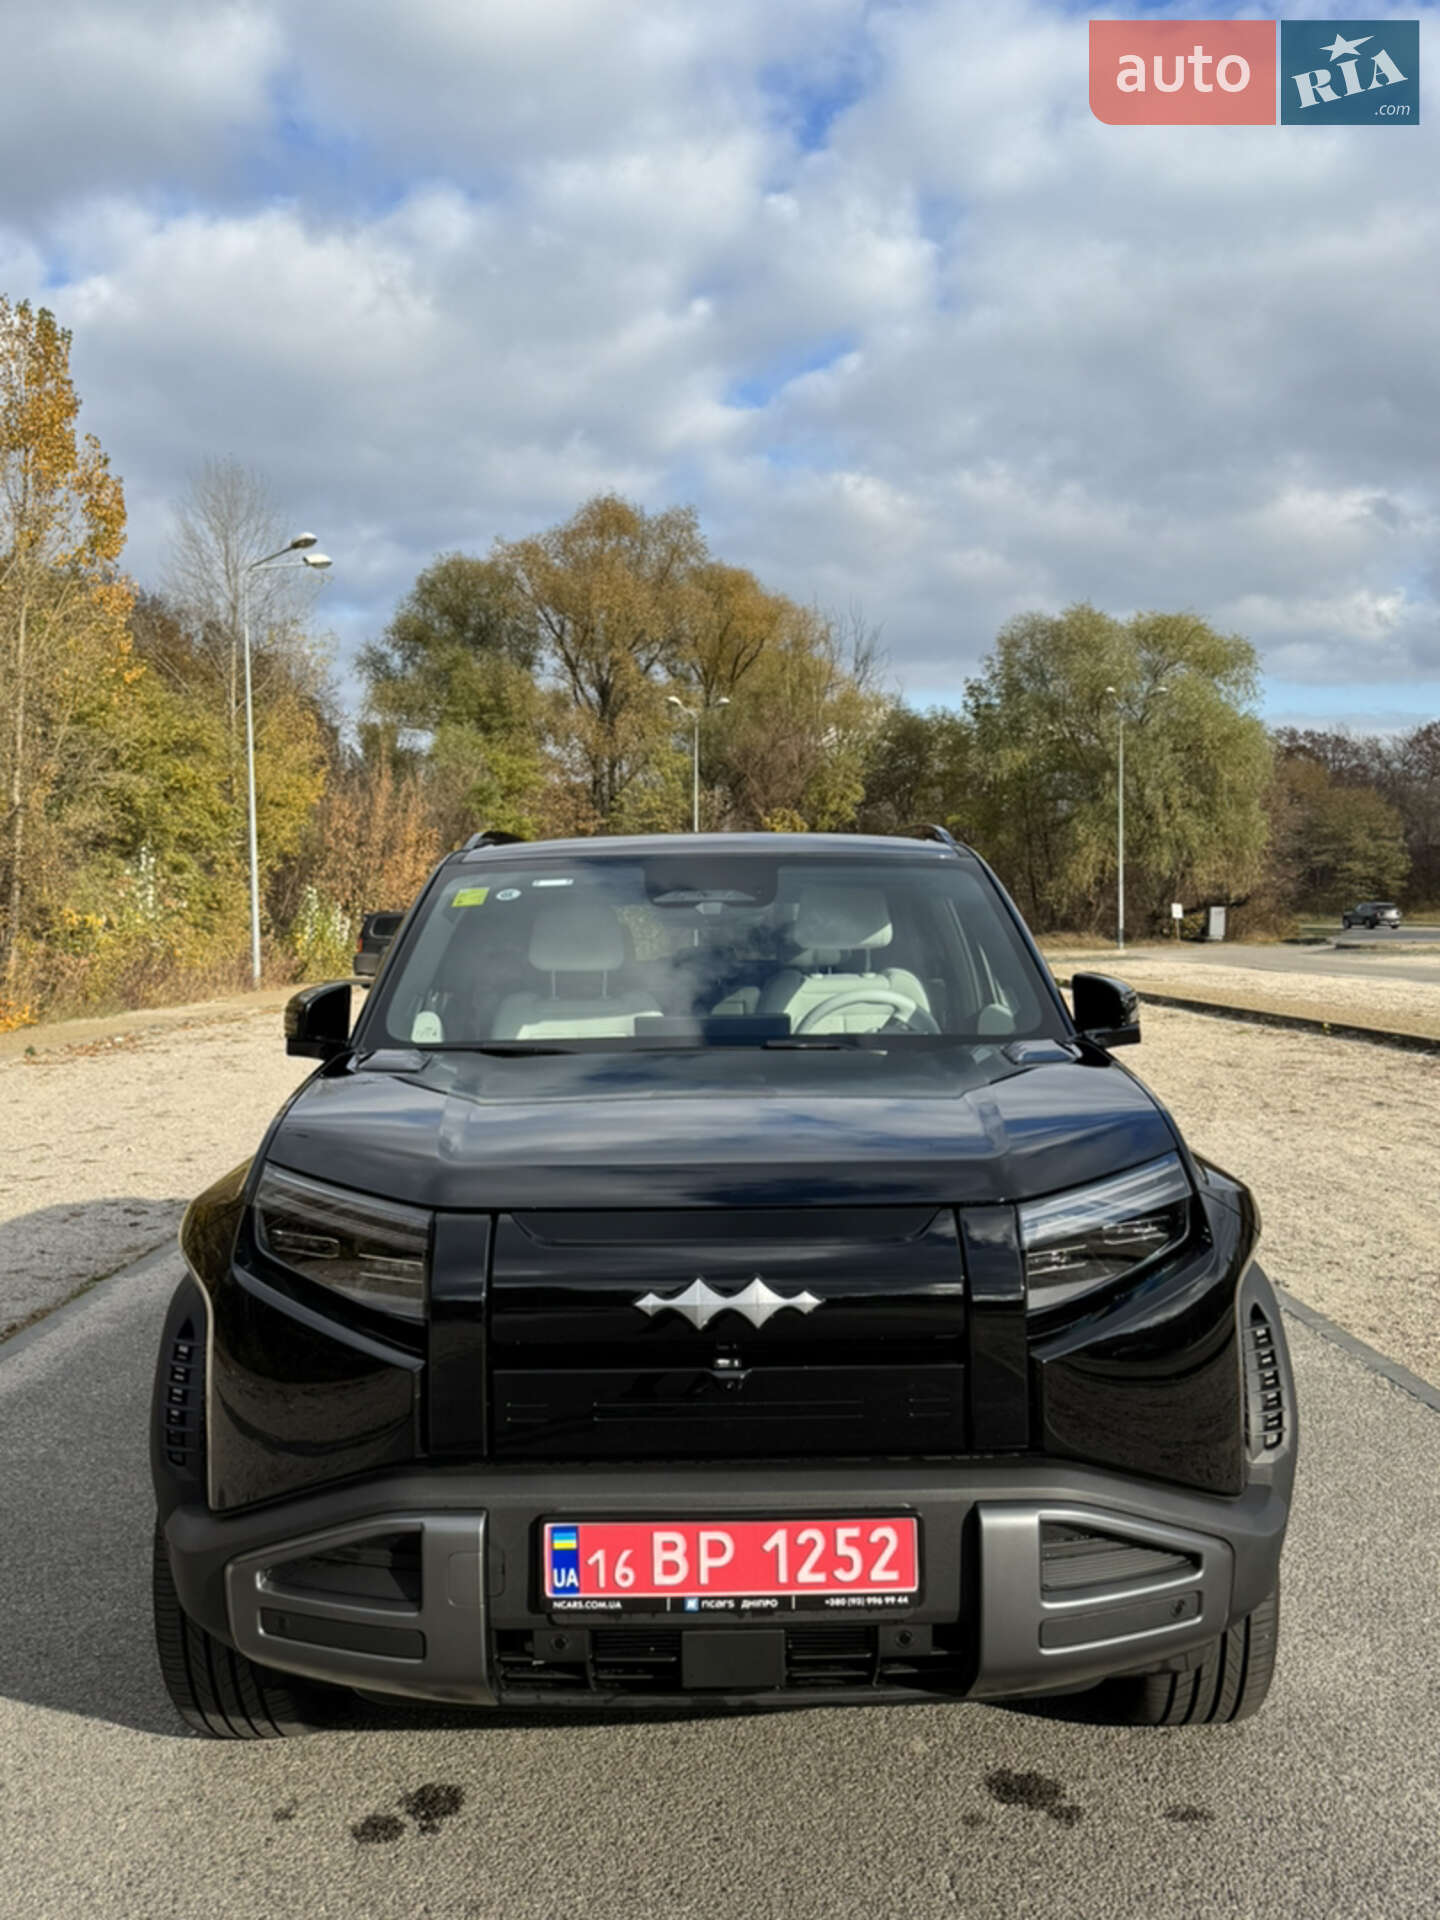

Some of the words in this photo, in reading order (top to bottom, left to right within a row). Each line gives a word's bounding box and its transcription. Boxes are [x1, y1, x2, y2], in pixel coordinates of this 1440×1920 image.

[586, 1549, 636, 1589] 16
[652, 1531, 735, 1586] BP
[761, 1526, 900, 1584] 1252
[553, 1568, 579, 1588] UA
[552, 1600, 623, 1610] NCARS.COM.UA
